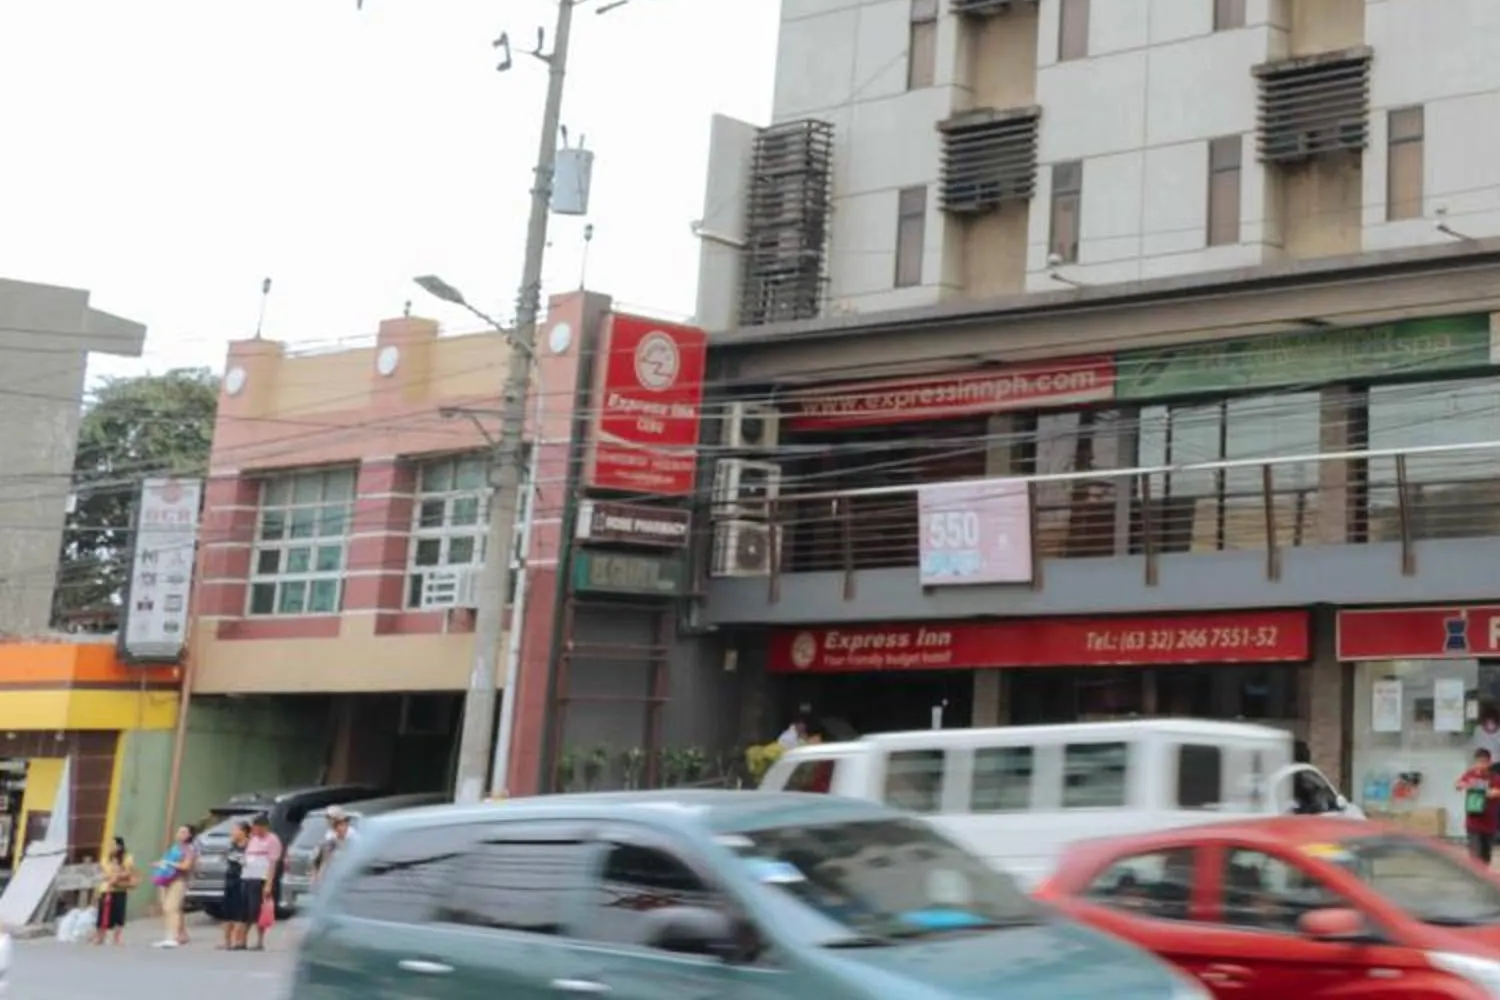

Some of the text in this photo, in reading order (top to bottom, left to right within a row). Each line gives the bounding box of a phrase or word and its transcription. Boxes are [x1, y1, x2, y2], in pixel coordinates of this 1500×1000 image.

[823, 626, 952, 653] Express Inn
[1176, 630, 1208, 649] 266
